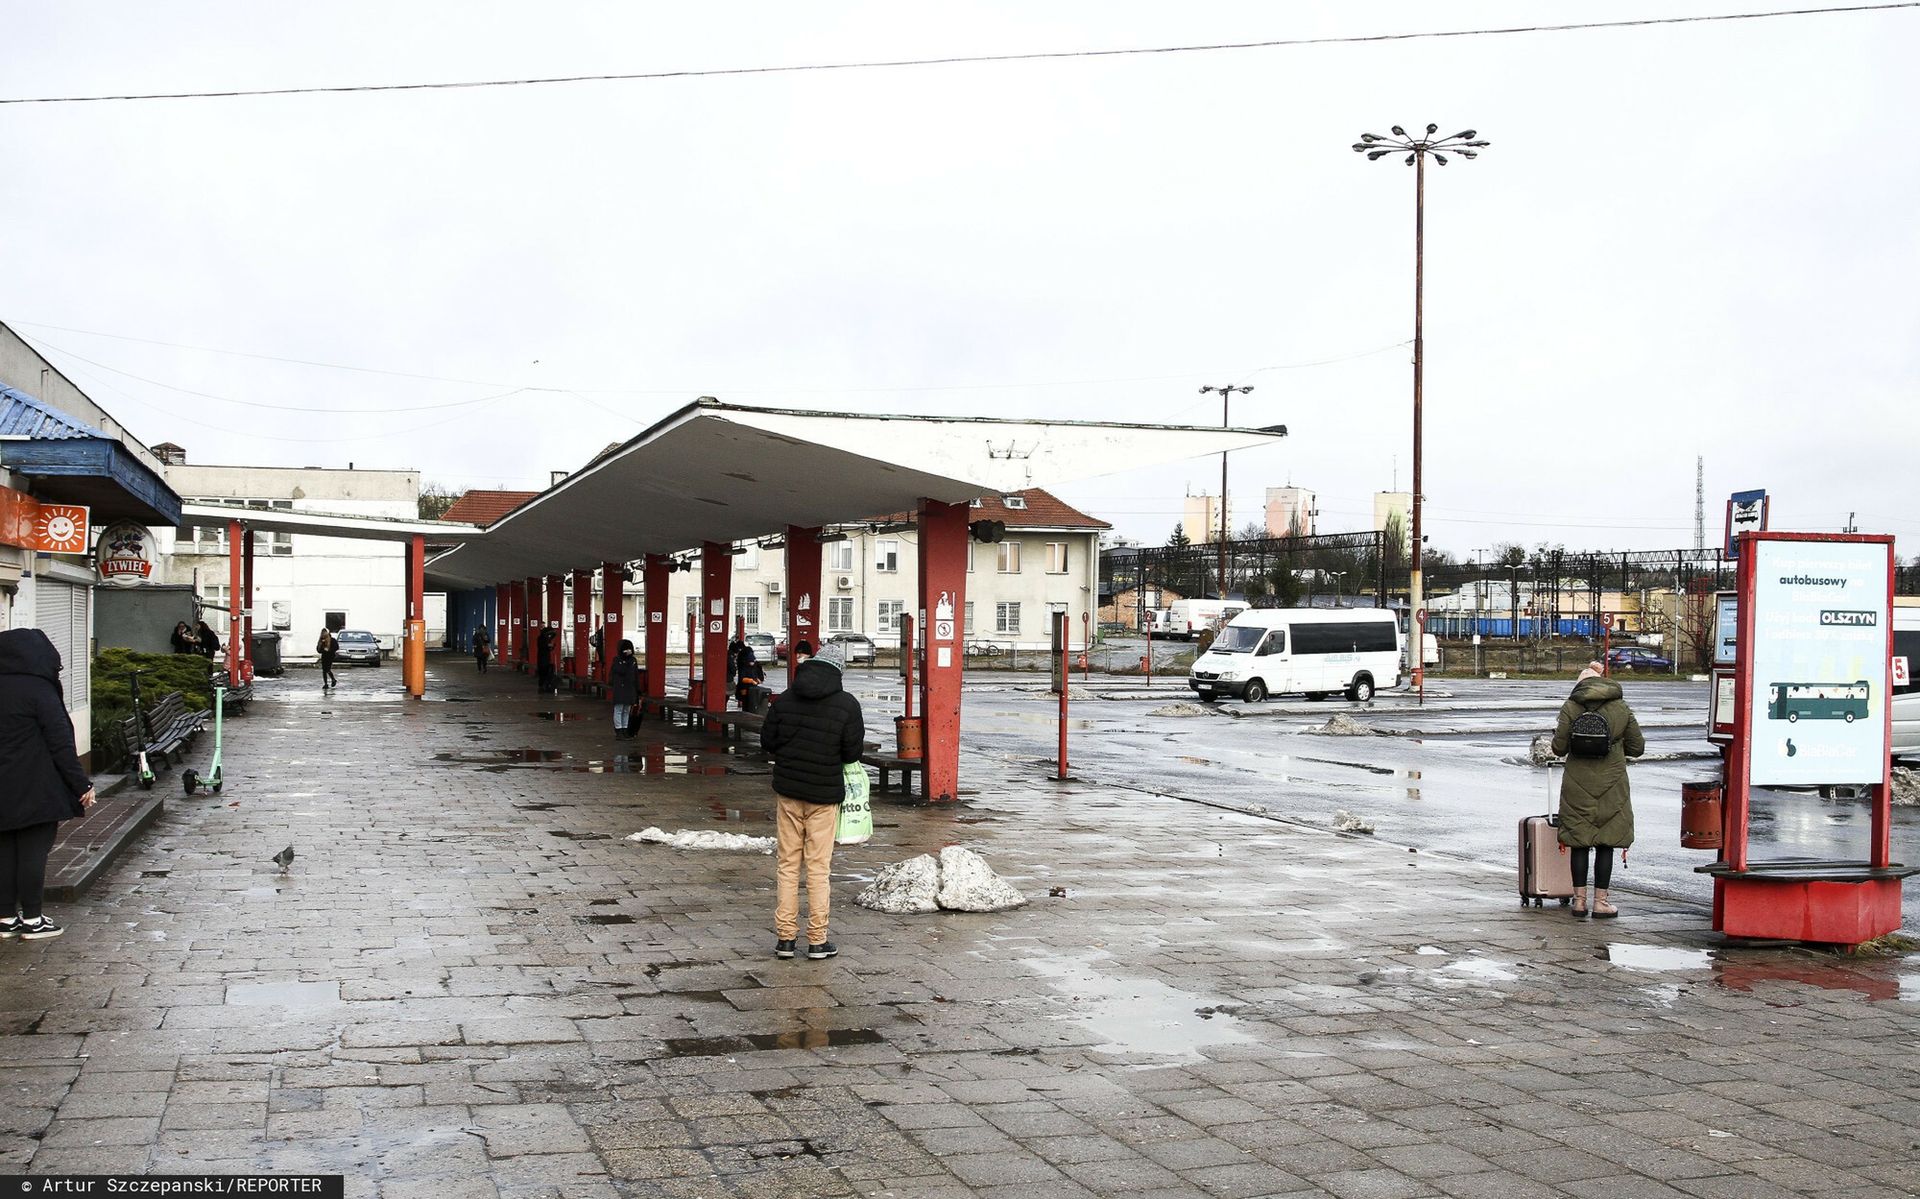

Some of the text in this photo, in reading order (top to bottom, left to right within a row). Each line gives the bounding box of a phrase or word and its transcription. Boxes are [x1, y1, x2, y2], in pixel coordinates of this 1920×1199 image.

[1779, 574, 1847, 589] autobusowy
[1603, 613, 1610, 625] 5
[1821, 612, 1876, 625] OLSZTYN
[1894, 658, 1903, 680] 5
